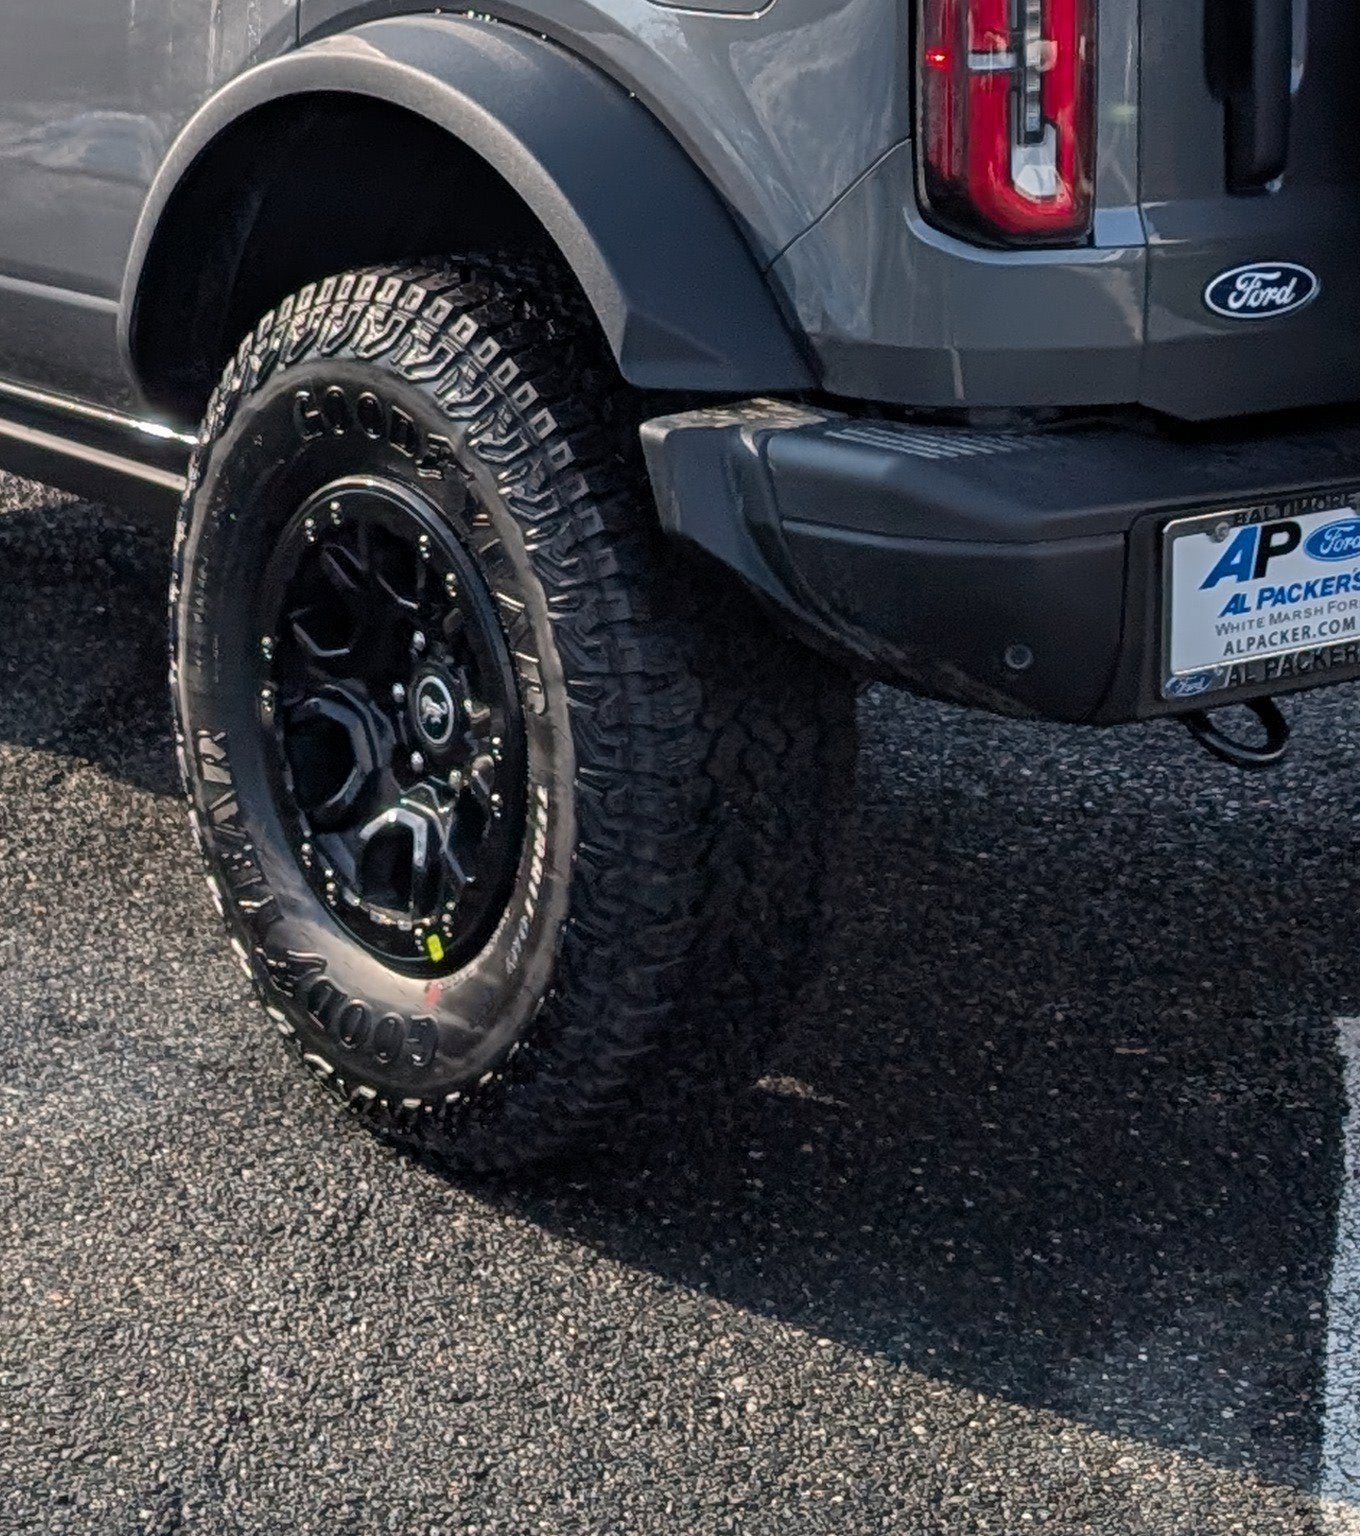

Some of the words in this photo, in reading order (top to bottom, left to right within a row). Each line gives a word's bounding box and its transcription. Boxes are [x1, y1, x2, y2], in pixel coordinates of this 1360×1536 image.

[1227, 271, 1298, 310] Ford
[1198, 520, 1302, 591] AP
[1215, 617, 1266, 637] WHITE
[1268, 606, 1325, 627] MARSH
[1217, 592, 1252, 619] AL
[1222, 615, 1357, 657] ALPACKER.COM
[1264, 642, 1360, 679] PACKER
